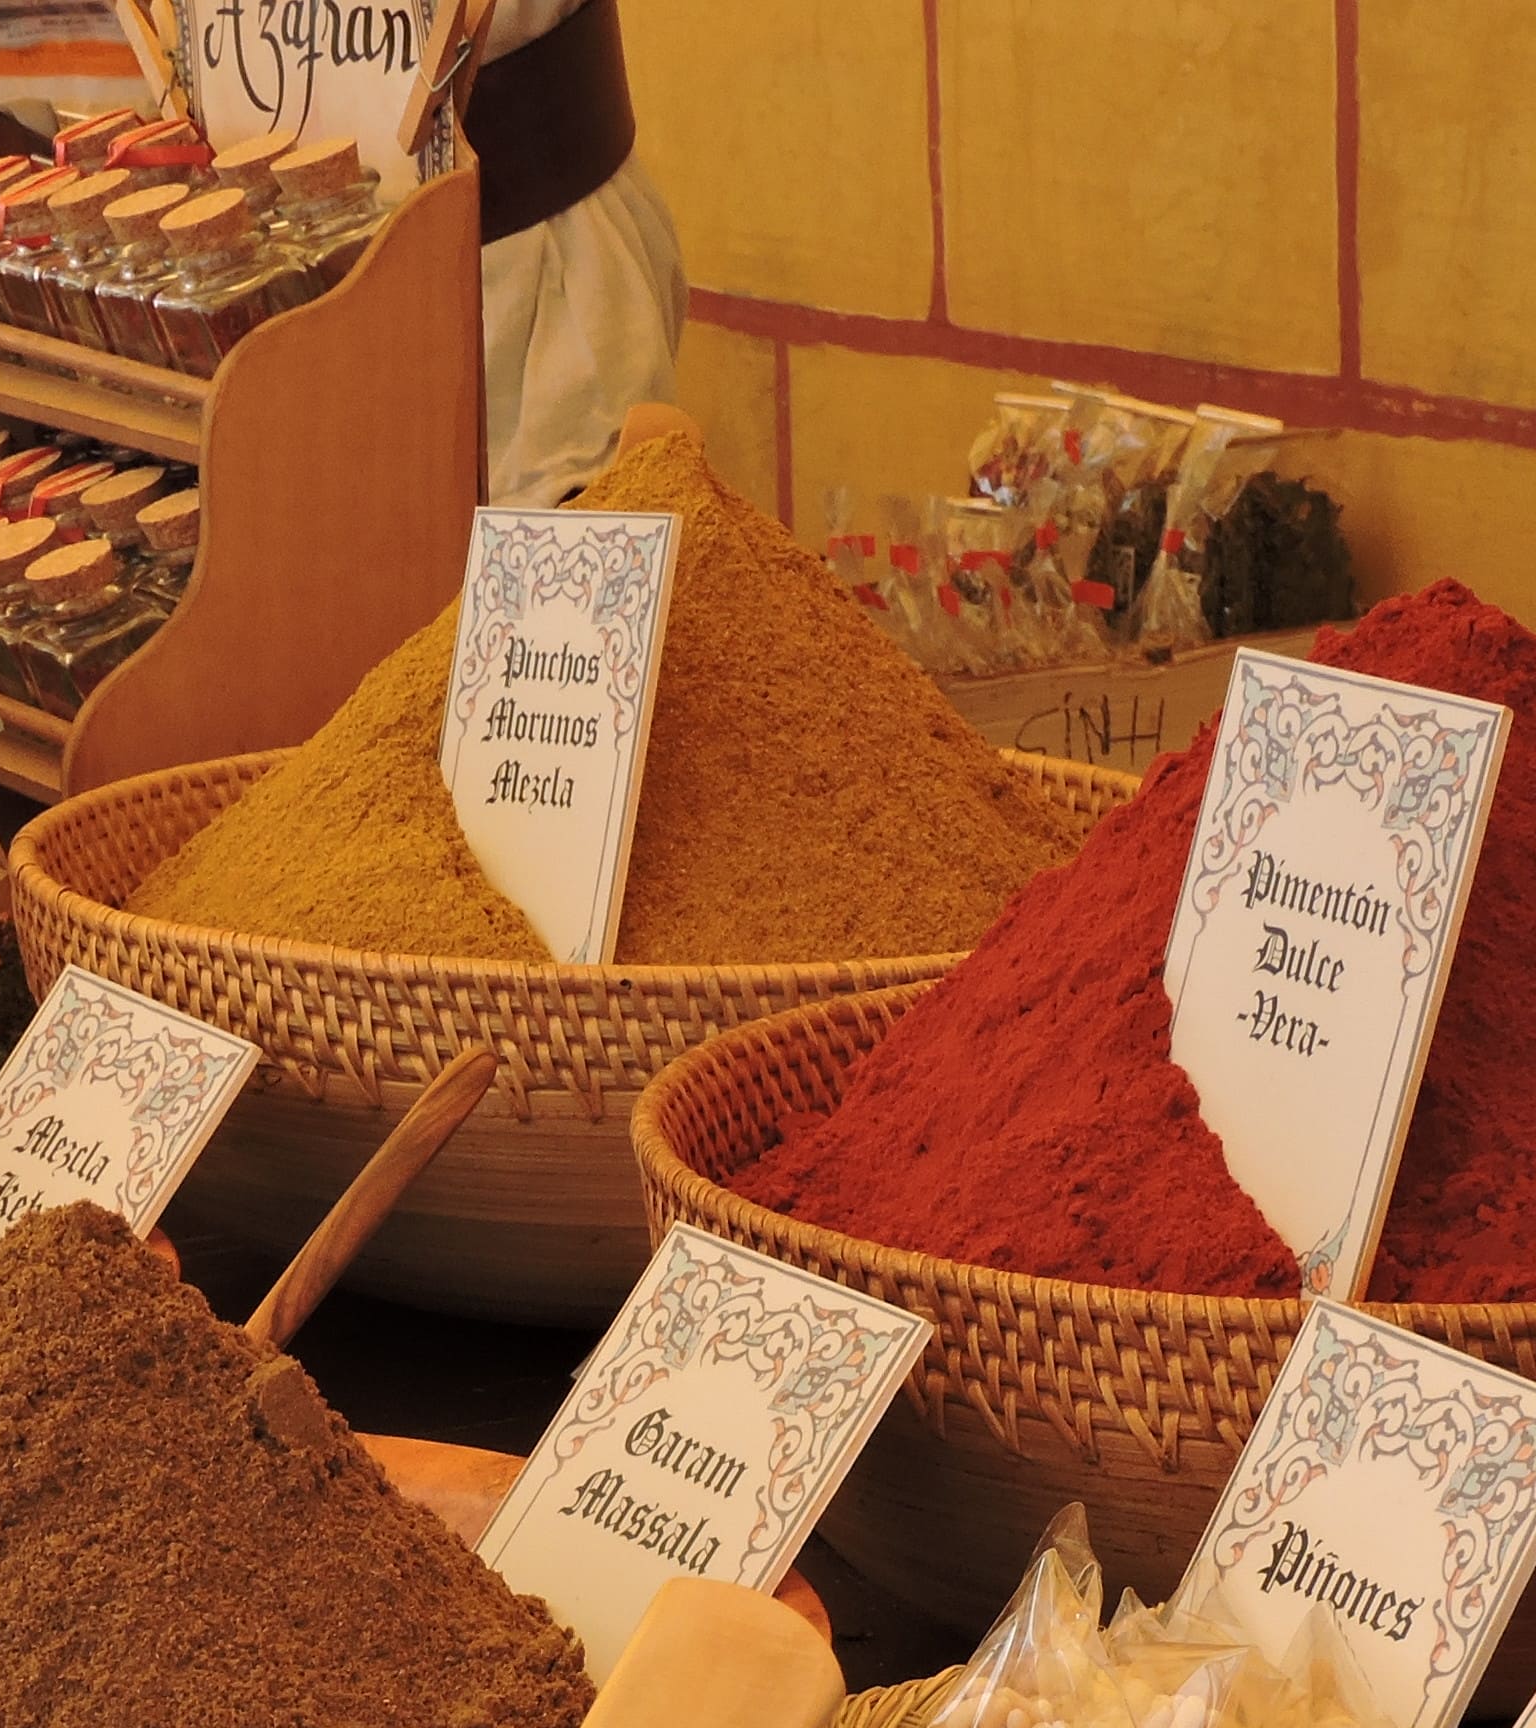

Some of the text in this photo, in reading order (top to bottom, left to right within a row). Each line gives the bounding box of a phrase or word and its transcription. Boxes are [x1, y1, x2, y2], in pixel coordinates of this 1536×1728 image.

[501, 635, 603, 690] Pinchos
[481, 697, 602, 749] Morunos
[485, 758, 575, 814] Mezcla
[1240, 849, 1393, 937] Pimentón
[1252, 920, 1346, 993] Dulce
[1236, 989, 1330, 1058] -Vera-
[13, 1114, 112, 1186] Mezcla
[624, 1407, 749, 1500] Garam
[557, 1467, 724, 1577] Massala
[1257, 1520, 1425, 1642] Piñones
